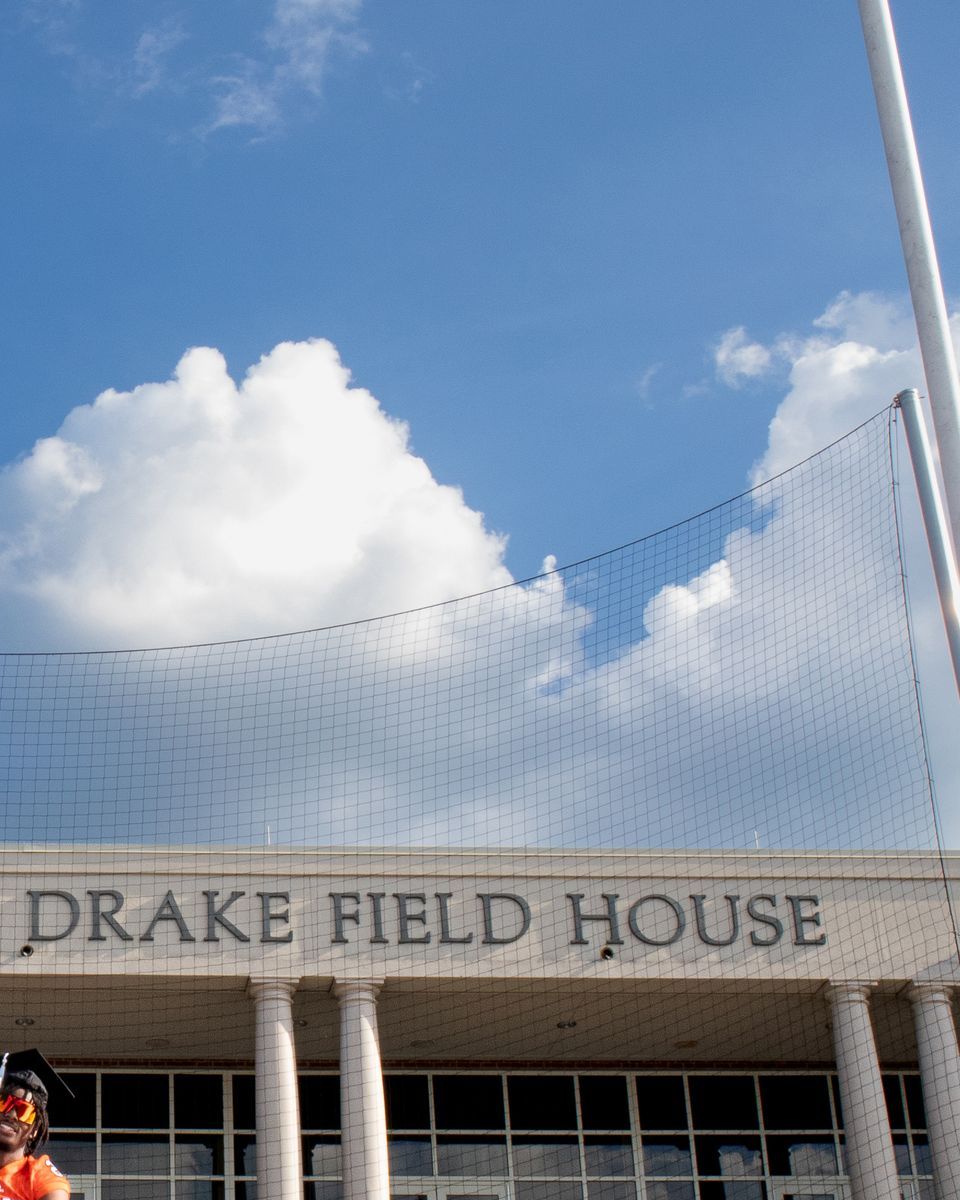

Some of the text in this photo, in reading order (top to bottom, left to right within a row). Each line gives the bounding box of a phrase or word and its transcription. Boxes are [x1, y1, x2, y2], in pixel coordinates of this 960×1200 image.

[26, 889, 294, 944] DRAKE
[328, 891, 532, 945] FIELD
[566, 893, 827, 947] HOUSE
